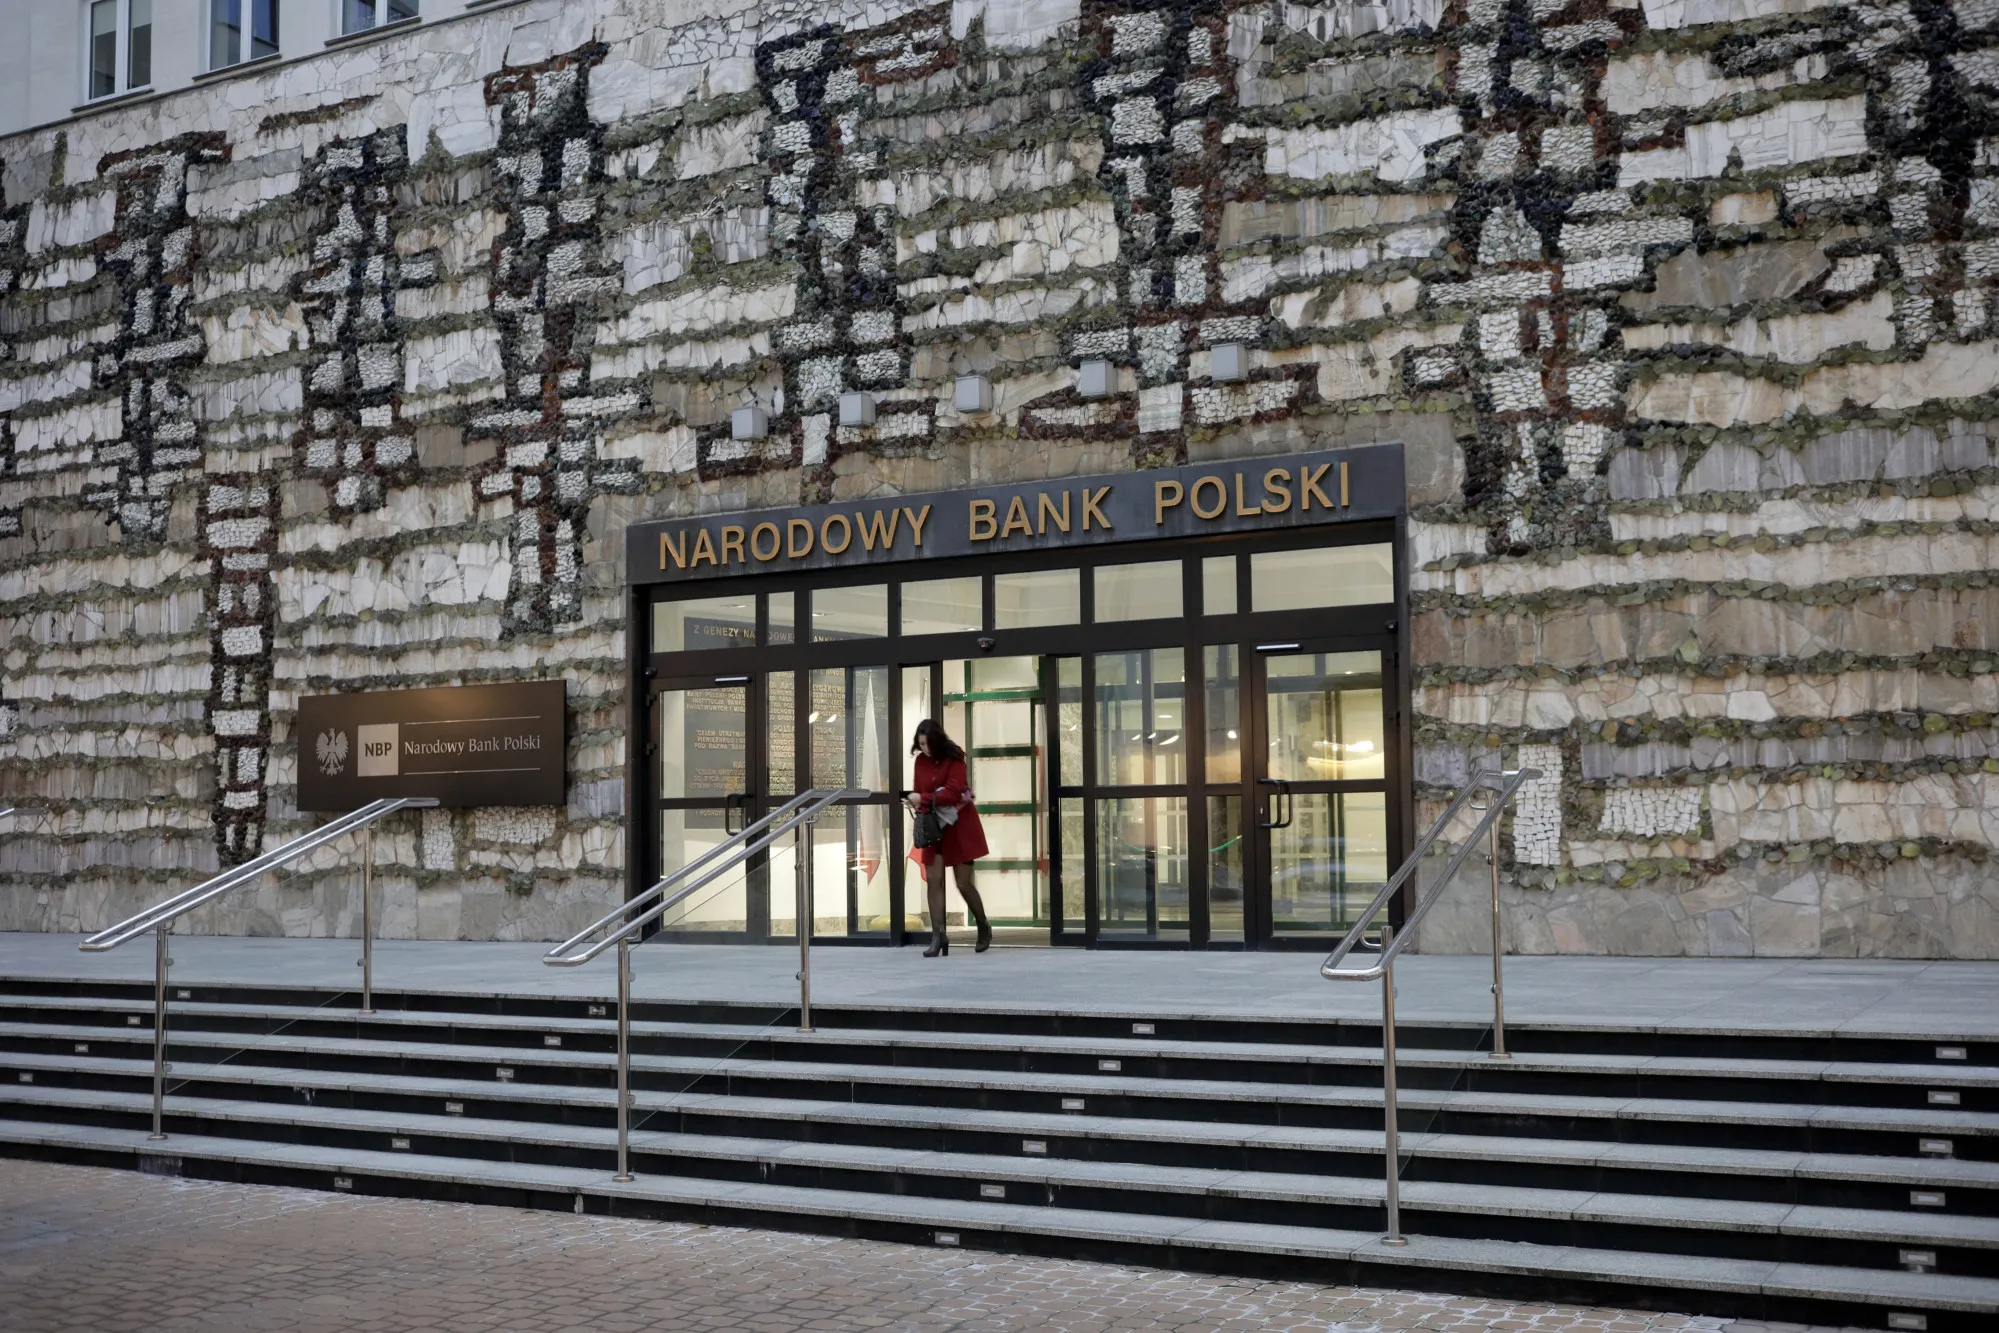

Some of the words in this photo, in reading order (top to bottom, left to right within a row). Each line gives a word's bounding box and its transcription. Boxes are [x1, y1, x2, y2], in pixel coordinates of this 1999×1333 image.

[658, 503, 932, 570] NARODOWY
[969, 485, 1114, 541] BANK
[1154, 461, 1350, 524] POLSKI
[703, 625, 739, 637] GENEZY
[364, 742, 392, 757] NBP
[404, 739, 465, 755] Narodowy
[468, 737, 500, 752] Bank
[504, 734, 541, 750] Polski
